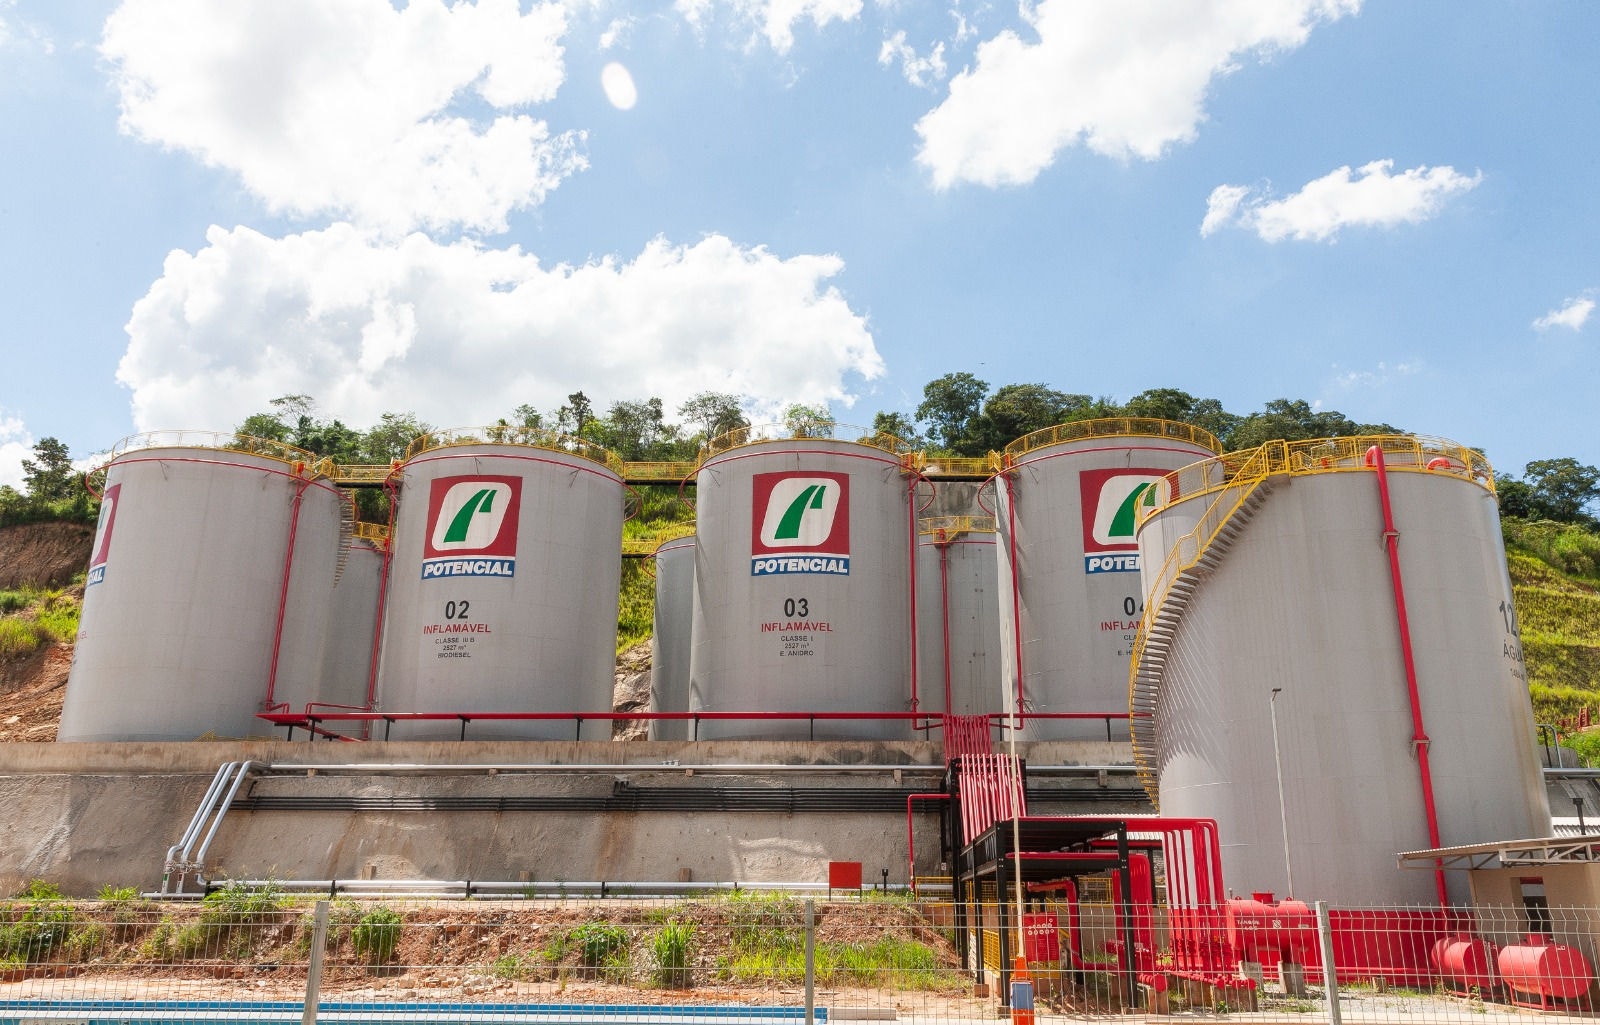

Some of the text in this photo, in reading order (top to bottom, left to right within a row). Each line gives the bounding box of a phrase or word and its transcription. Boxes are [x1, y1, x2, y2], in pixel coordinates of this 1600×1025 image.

[423, 561, 513, 577] POTENCIAL
[754, 558, 848, 574] POTENCIAL
[445, 600, 470, 620] 02
[784, 598, 809, 618] 03
[1123, 597, 1144, 616] 0
[761, 620, 833, 632] INFLAMÁVEL
[1499, 600, 1518, 637] 12
[423, 621, 492, 634] INFLAMÁVEL
[437, 651, 472, 659] BIODIESEL
